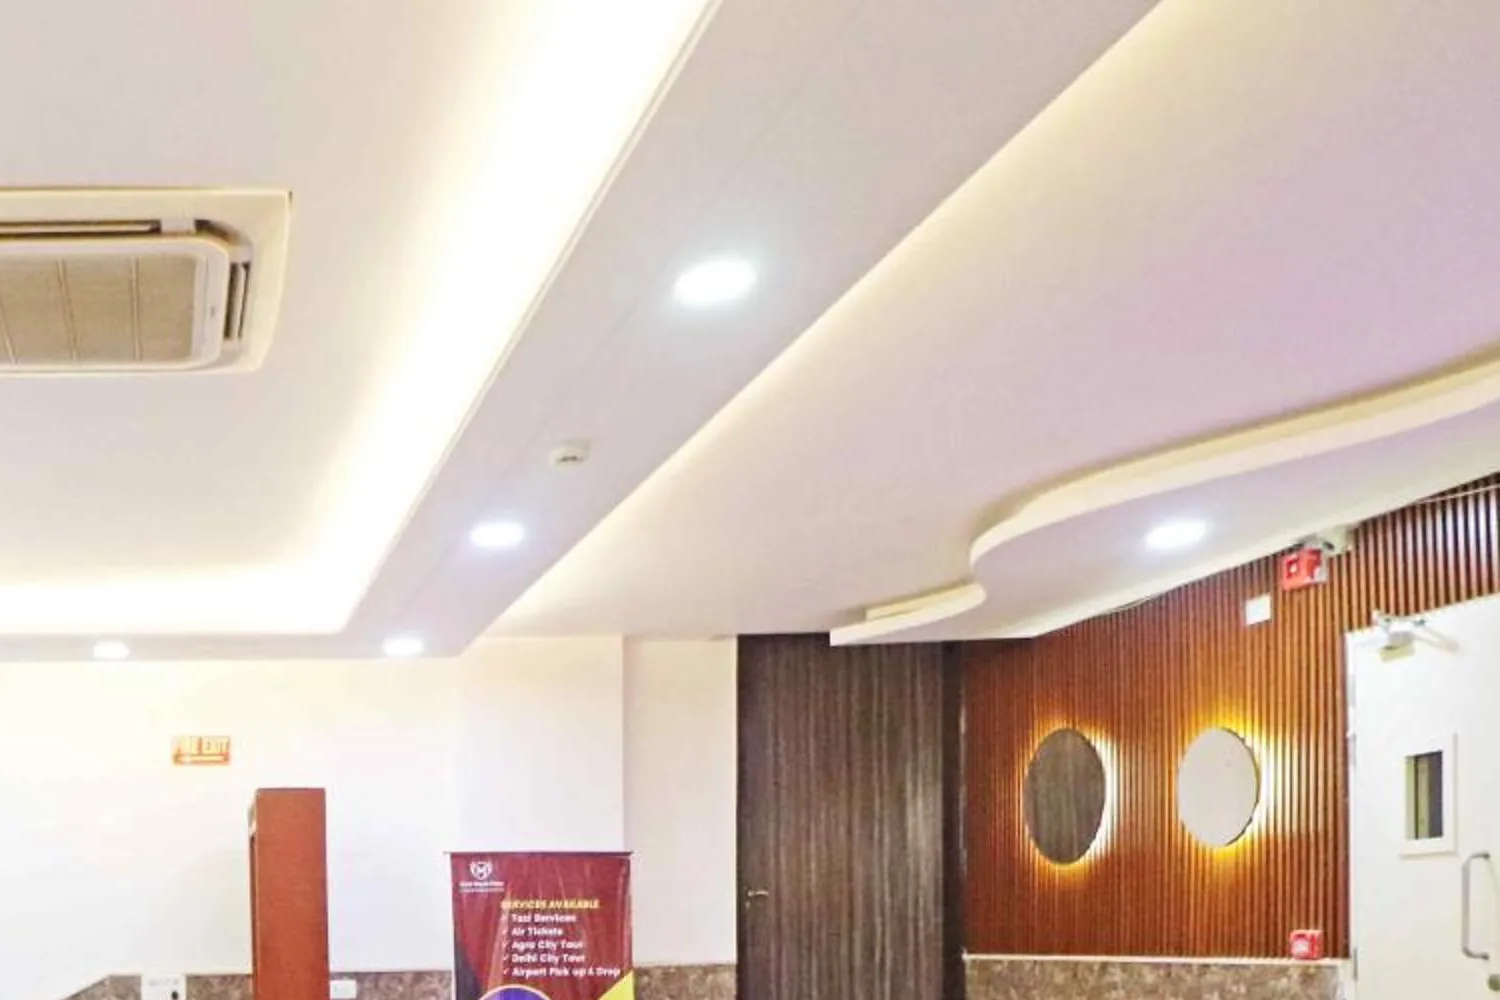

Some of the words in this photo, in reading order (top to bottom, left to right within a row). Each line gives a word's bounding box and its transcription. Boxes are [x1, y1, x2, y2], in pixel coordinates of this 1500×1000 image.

[511, 913, 531, 922] Taxi
[534, 913, 576, 922] Services
[511, 927, 525, 936] Air
[528, 927, 563, 936] Tickets
[511, 940, 536, 952] Agra
[538, 940, 557, 952] City
[560, 940, 584, 949] Tour
[511, 954, 538, 963] Delhi
[539, 954, 559, 965] City
[563, 954, 586, 963] Tour
[512, 967, 547, 980] Airport
[549, 967, 570, 976] Pick
[596, 967, 621, 979] Drop
